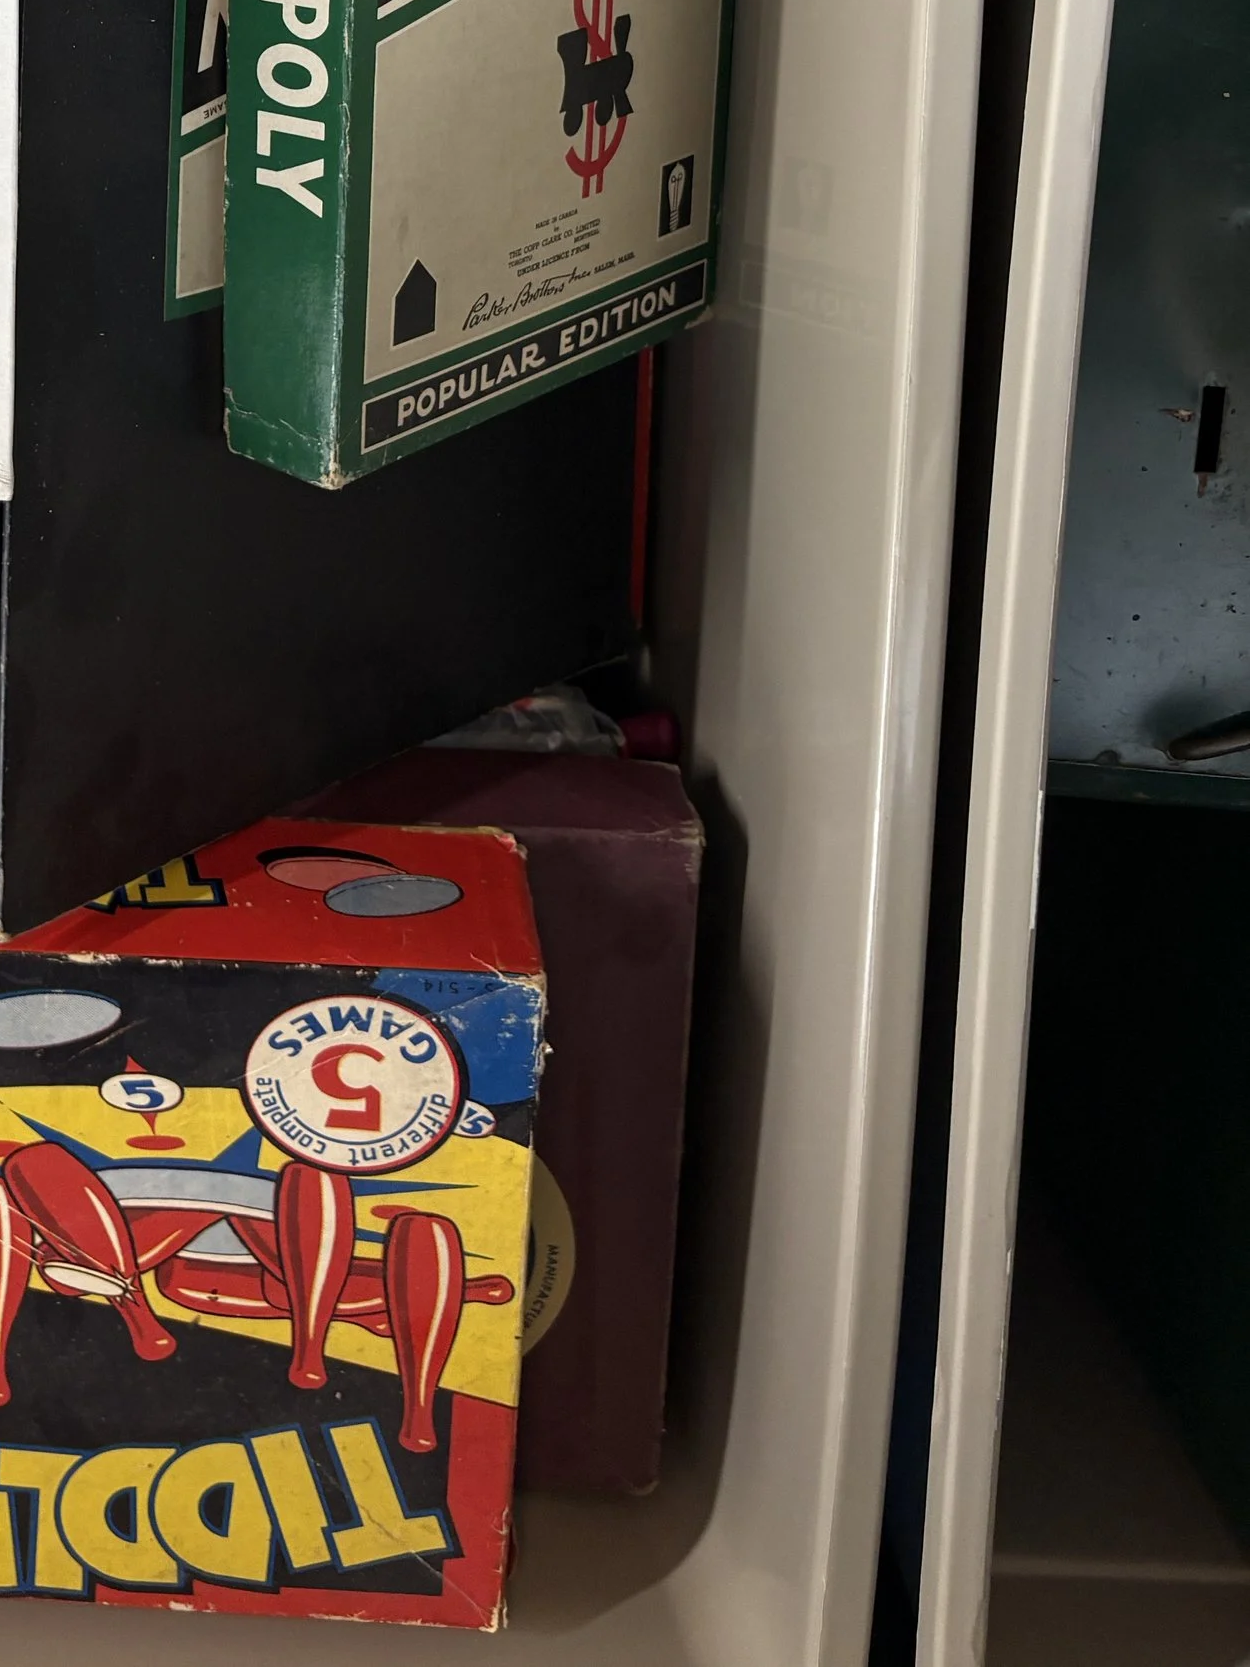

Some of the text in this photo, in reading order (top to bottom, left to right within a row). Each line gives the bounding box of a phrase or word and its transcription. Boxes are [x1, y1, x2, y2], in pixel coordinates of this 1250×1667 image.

[508, 248, 523, 260] THE
[541, 234, 563, 248] CLARK
[575, 218, 601, 235] LIMITED
[517, 262, 540, 277] UNDER
[571, 242, 591, 258] FROM
[462, 292, 514, 331] Parker
[397, 281, 677, 427] POPULAR EDITION
[269, 1005, 438, 1064] GAMES
[120, 1079, 165, 1109] 5
[312, 1043, 385, 1132] 5
[252, 1076, 451, 1167] different complete
